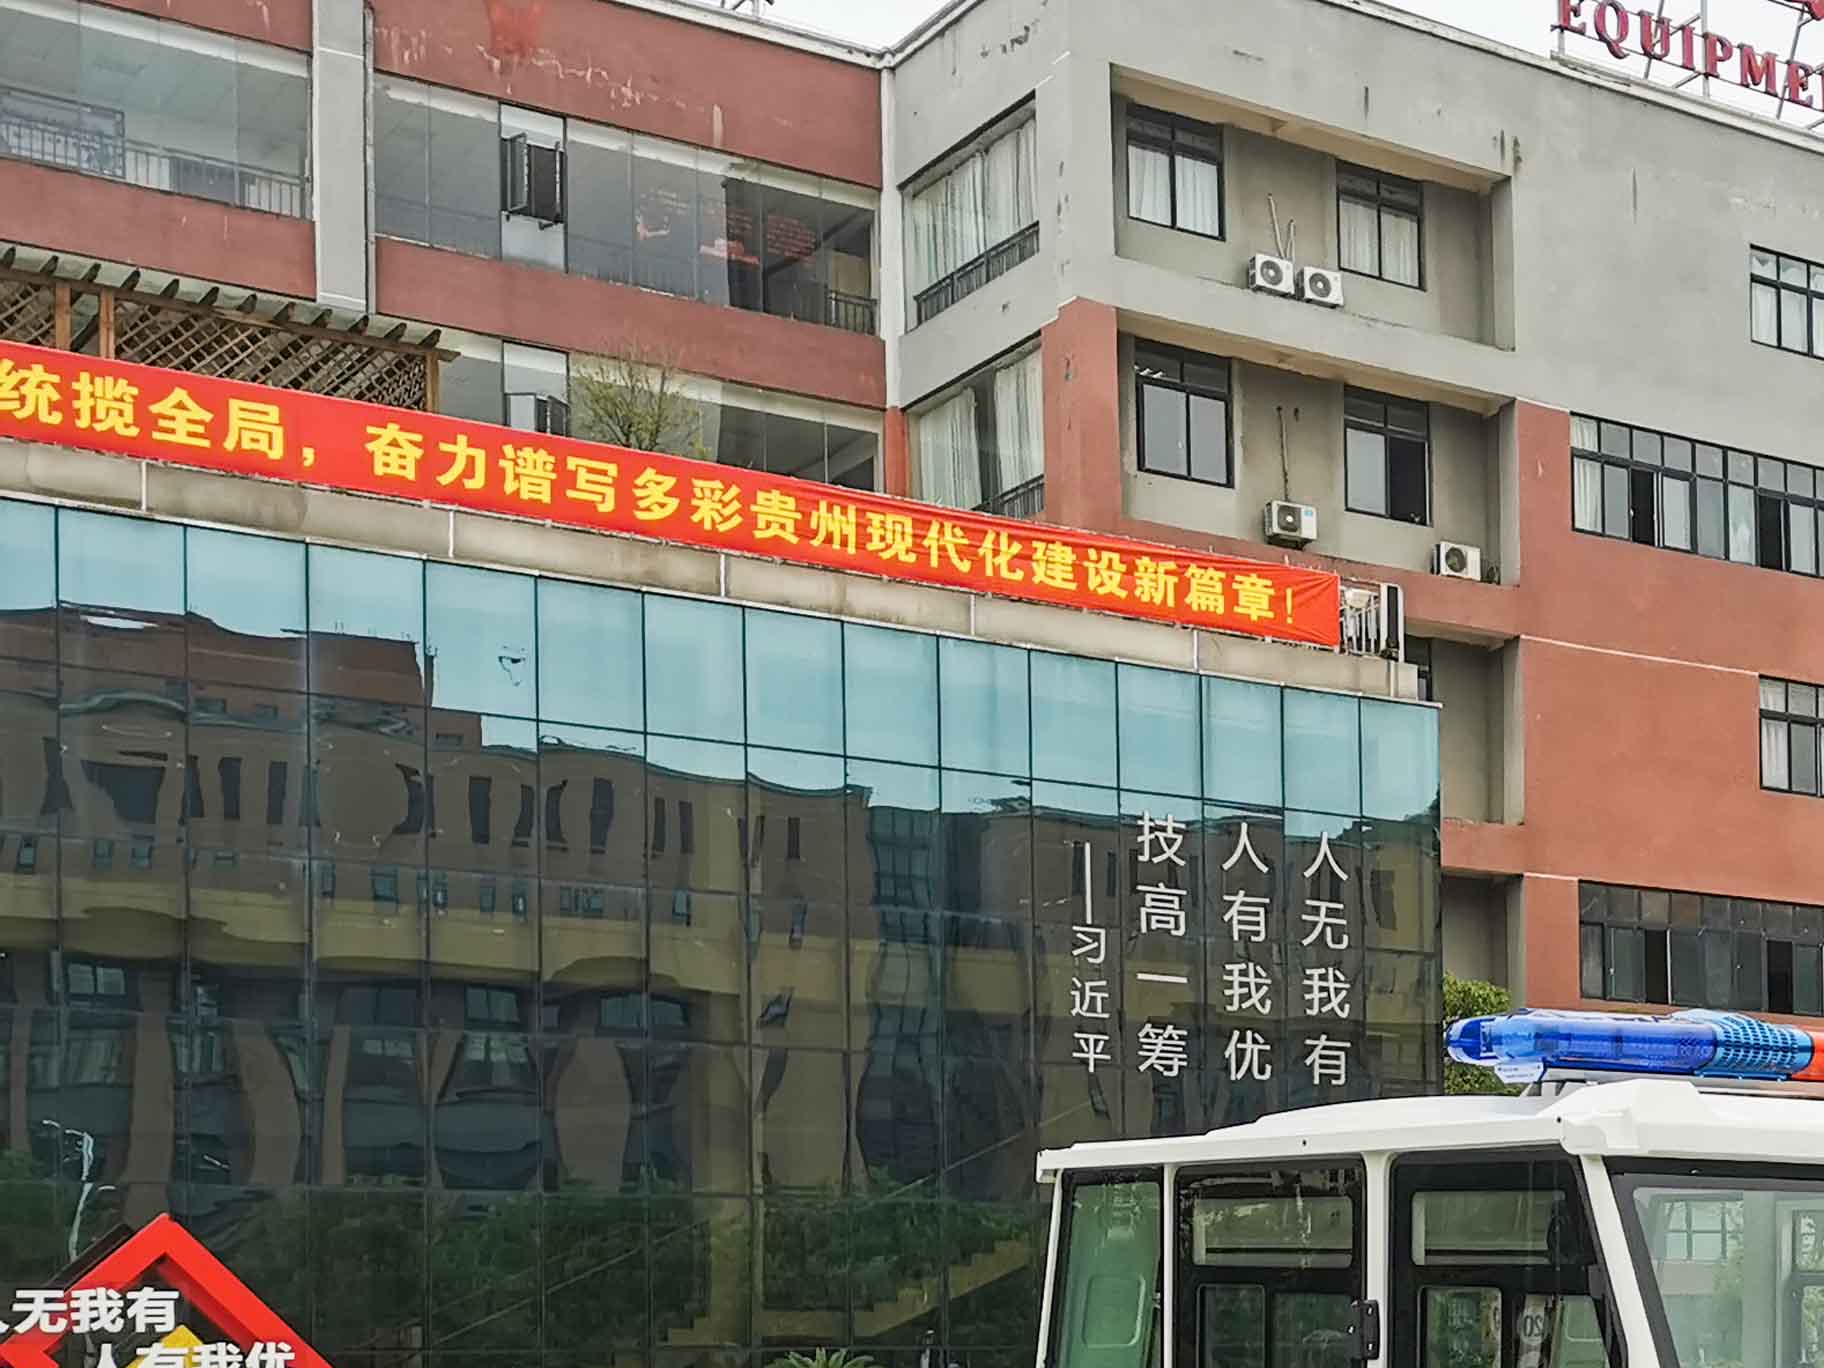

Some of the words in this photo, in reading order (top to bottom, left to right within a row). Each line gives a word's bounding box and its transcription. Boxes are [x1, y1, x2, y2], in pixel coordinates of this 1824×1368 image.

[1136, 811, 1188, 1077] 技高一筹
[1221, 822, 1272, 1081] 人有我优
[1301, 831, 1351, 1086] 人无我有
[0, 1286, 180, 1334] 无我有
